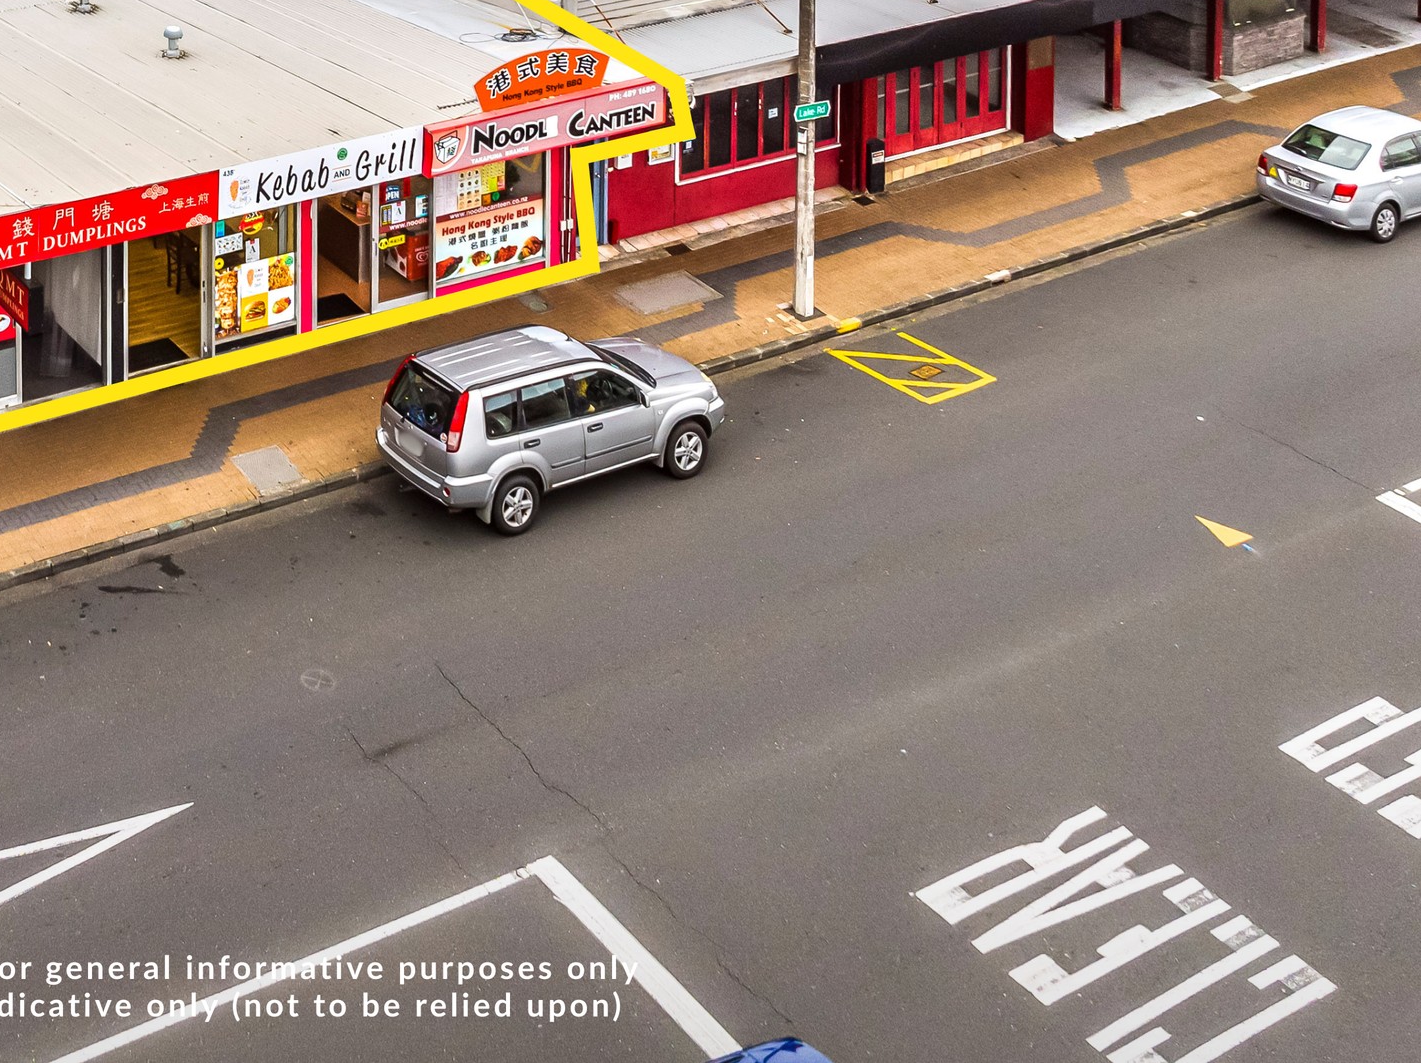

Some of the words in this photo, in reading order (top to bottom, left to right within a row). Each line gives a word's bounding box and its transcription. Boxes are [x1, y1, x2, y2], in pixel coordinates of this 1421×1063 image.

[486, 53, 598, 98] 港式美食
[502, 91, 522, 103] Hong
[524, 87, 543, 99] Kong
[545, 82, 564, 94] Style
[566, 77, 583, 88] BBQ
[609, 92, 622, 102] PH:
[623, 89, 637, 100] 489
[799, 108, 815, 118] Lake
[816, 105, 826, 114] Rd
[473, 116, 551, 154] NOODL
[568, 103, 657, 137] CANTEEN
[256, 157, 329, 204] Kebab
[333, 168, 351, 179] AND
[355, 138, 416, 182] Grill
[471, 152, 502, 165] TAKAPUNA
[505, 146, 529, 157] BRANCH
[158, 192, 209, 214] 上海生煎
[12, 200, 115, 240] 錢門塘
[43, 215, 147, 251] DUMPLINGS
[442, 224, 466, 237] Hong
[468, 218, 491, 230] Kong
[493, 212, 514, 225] Style
[517, 206, 535, 218] BBQ
